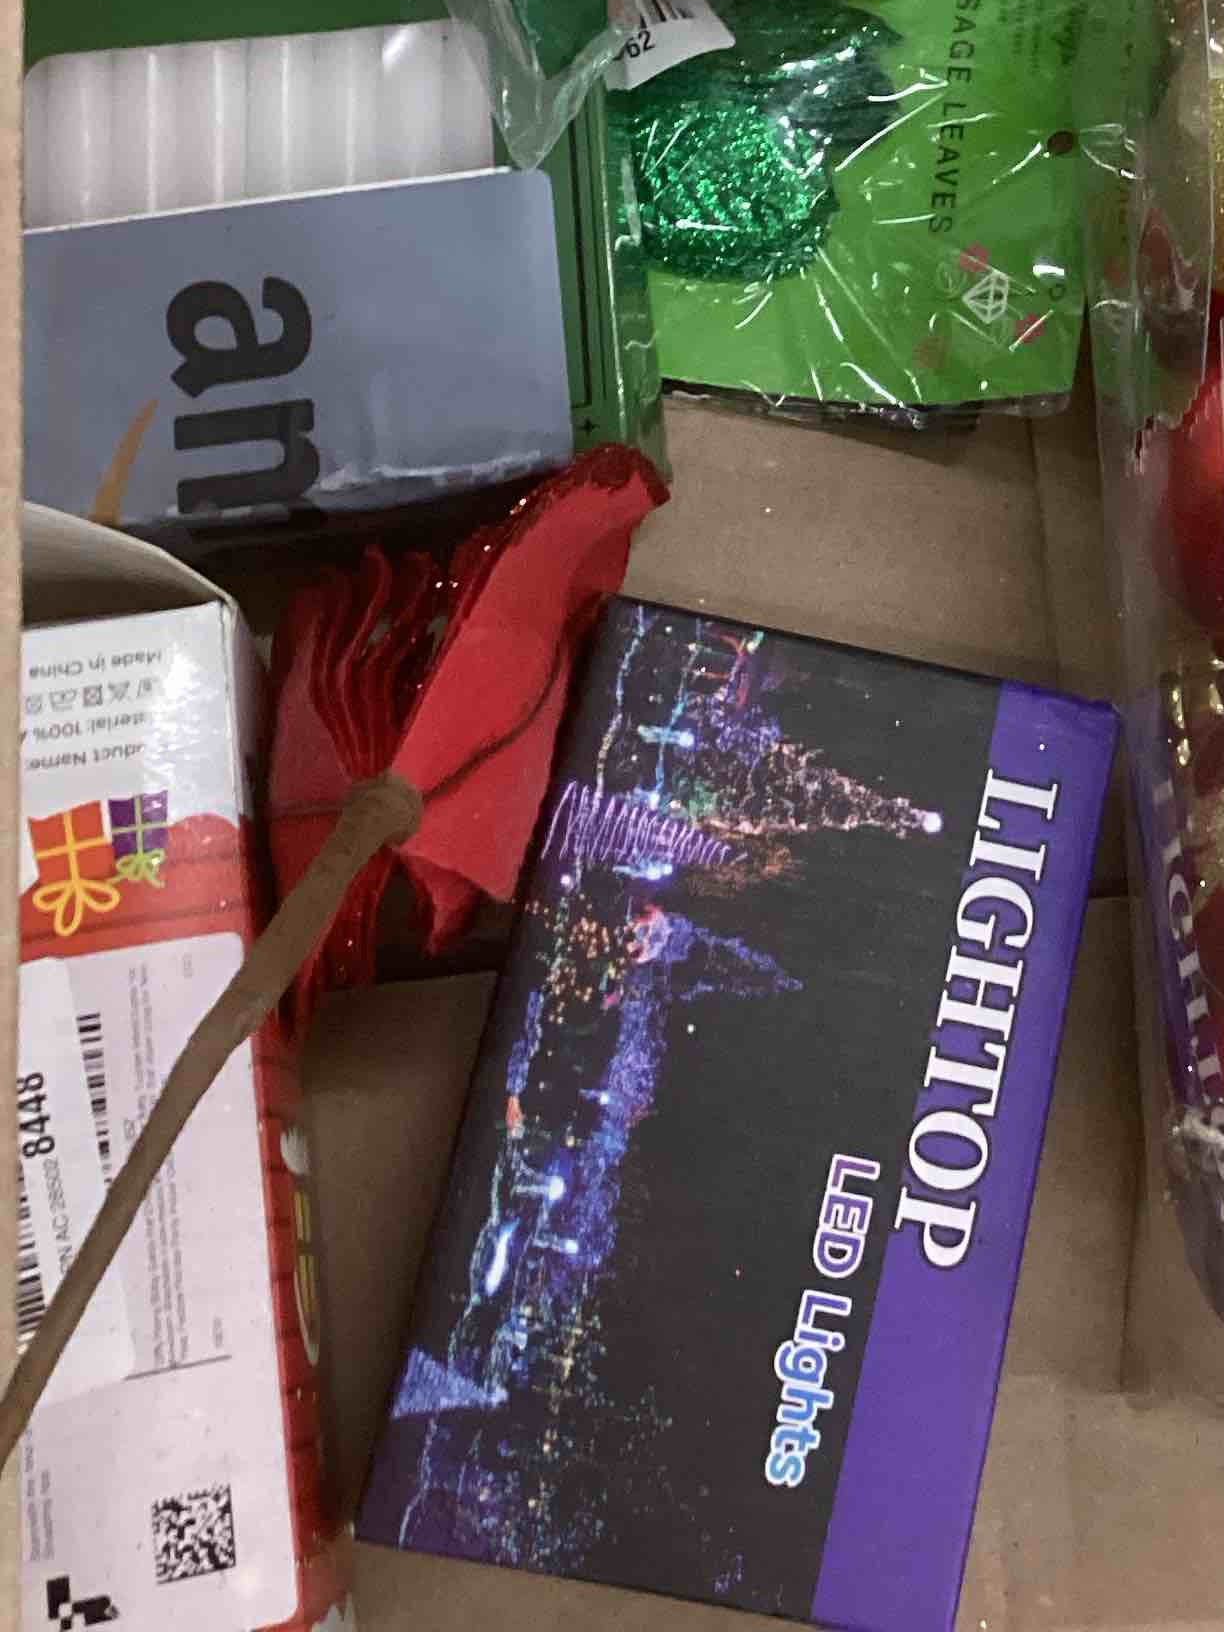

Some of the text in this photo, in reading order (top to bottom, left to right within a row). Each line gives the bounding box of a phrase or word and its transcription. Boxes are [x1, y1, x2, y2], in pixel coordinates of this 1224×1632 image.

[929, 103, 965, 232] LEAVES
[28, 650, 161, 679] Made in China
[32, 721, 80, 741] 100%
[893, 769, 1057, 1267] LIGHTOP
[15, 1071, 54, 1157] 8448
[765, 1153, 880, 1488] LED Lights
